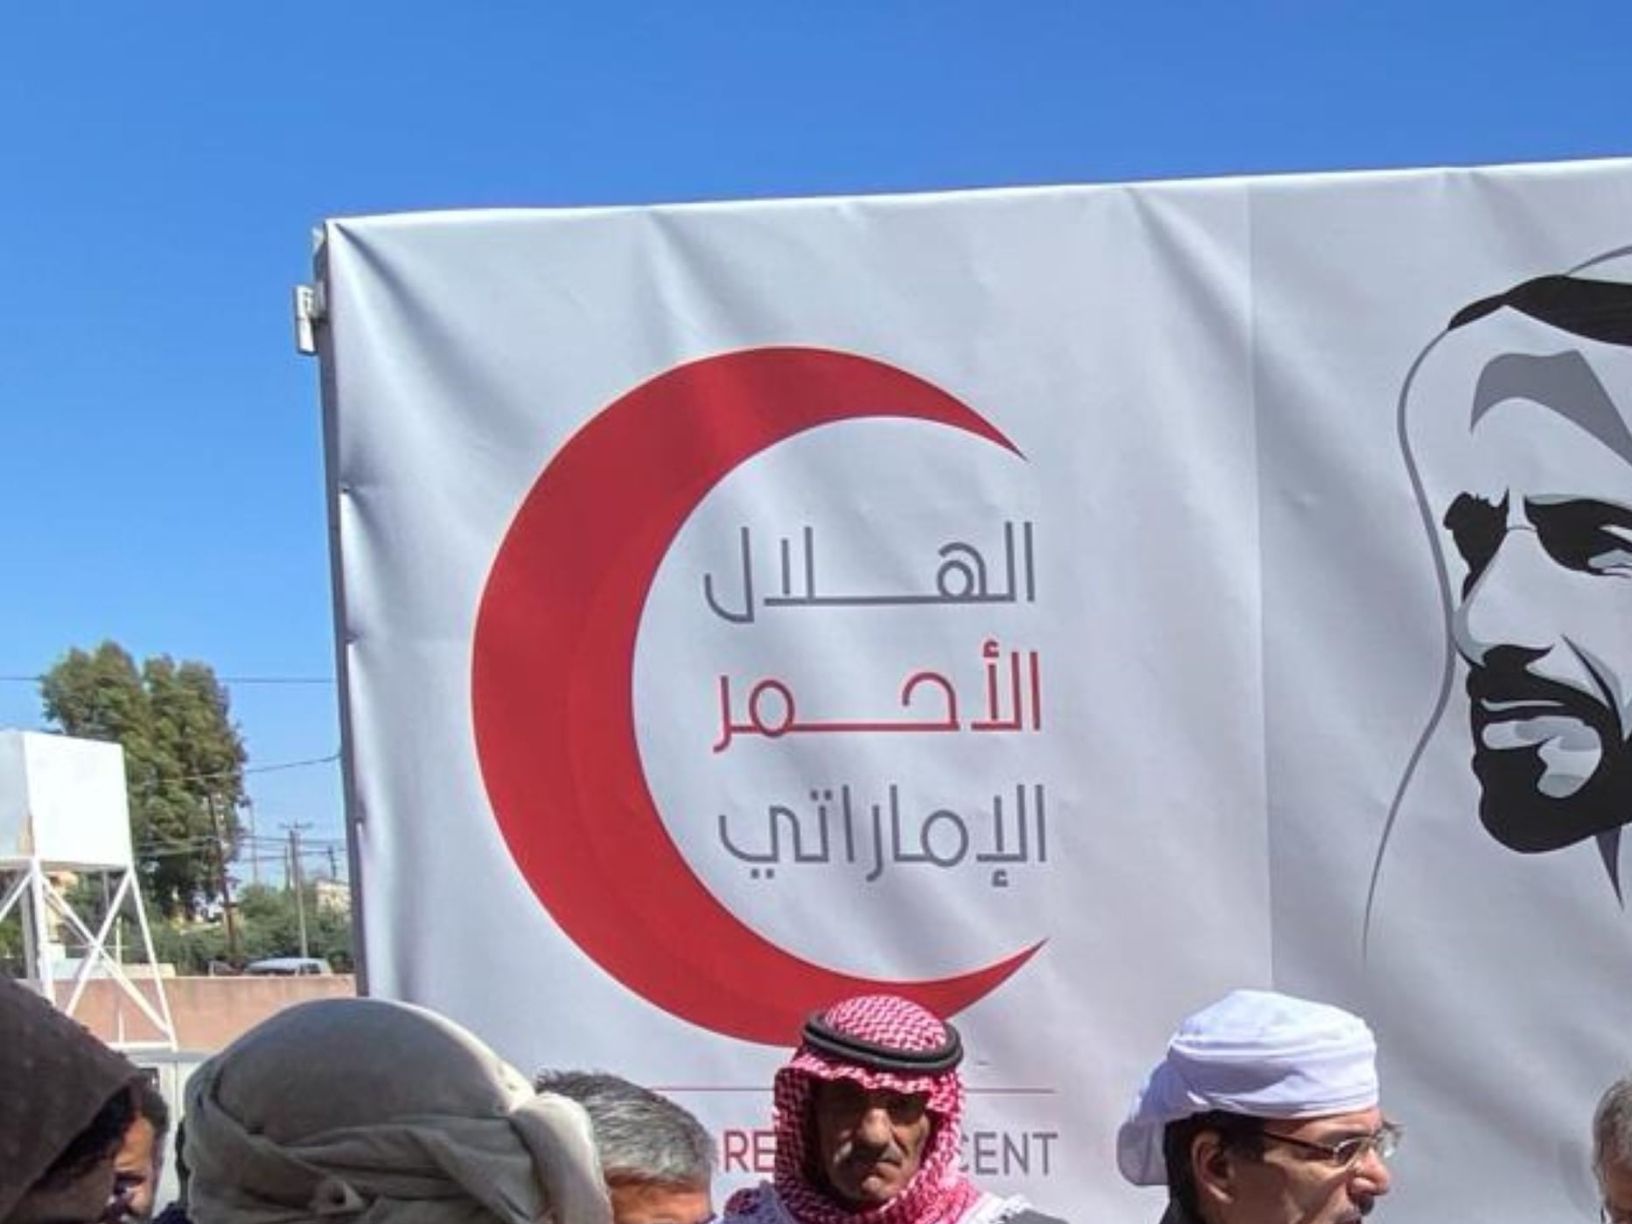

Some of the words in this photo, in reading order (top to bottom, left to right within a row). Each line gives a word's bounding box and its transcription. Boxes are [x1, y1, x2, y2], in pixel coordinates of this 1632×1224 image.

[704, 522, 1036, 623] الهلال
[713, 640, 1042, 753] الأحمر
[718, 784, 1048, 887] الإماراتي
[723, 1131, 776, 1173] RE
